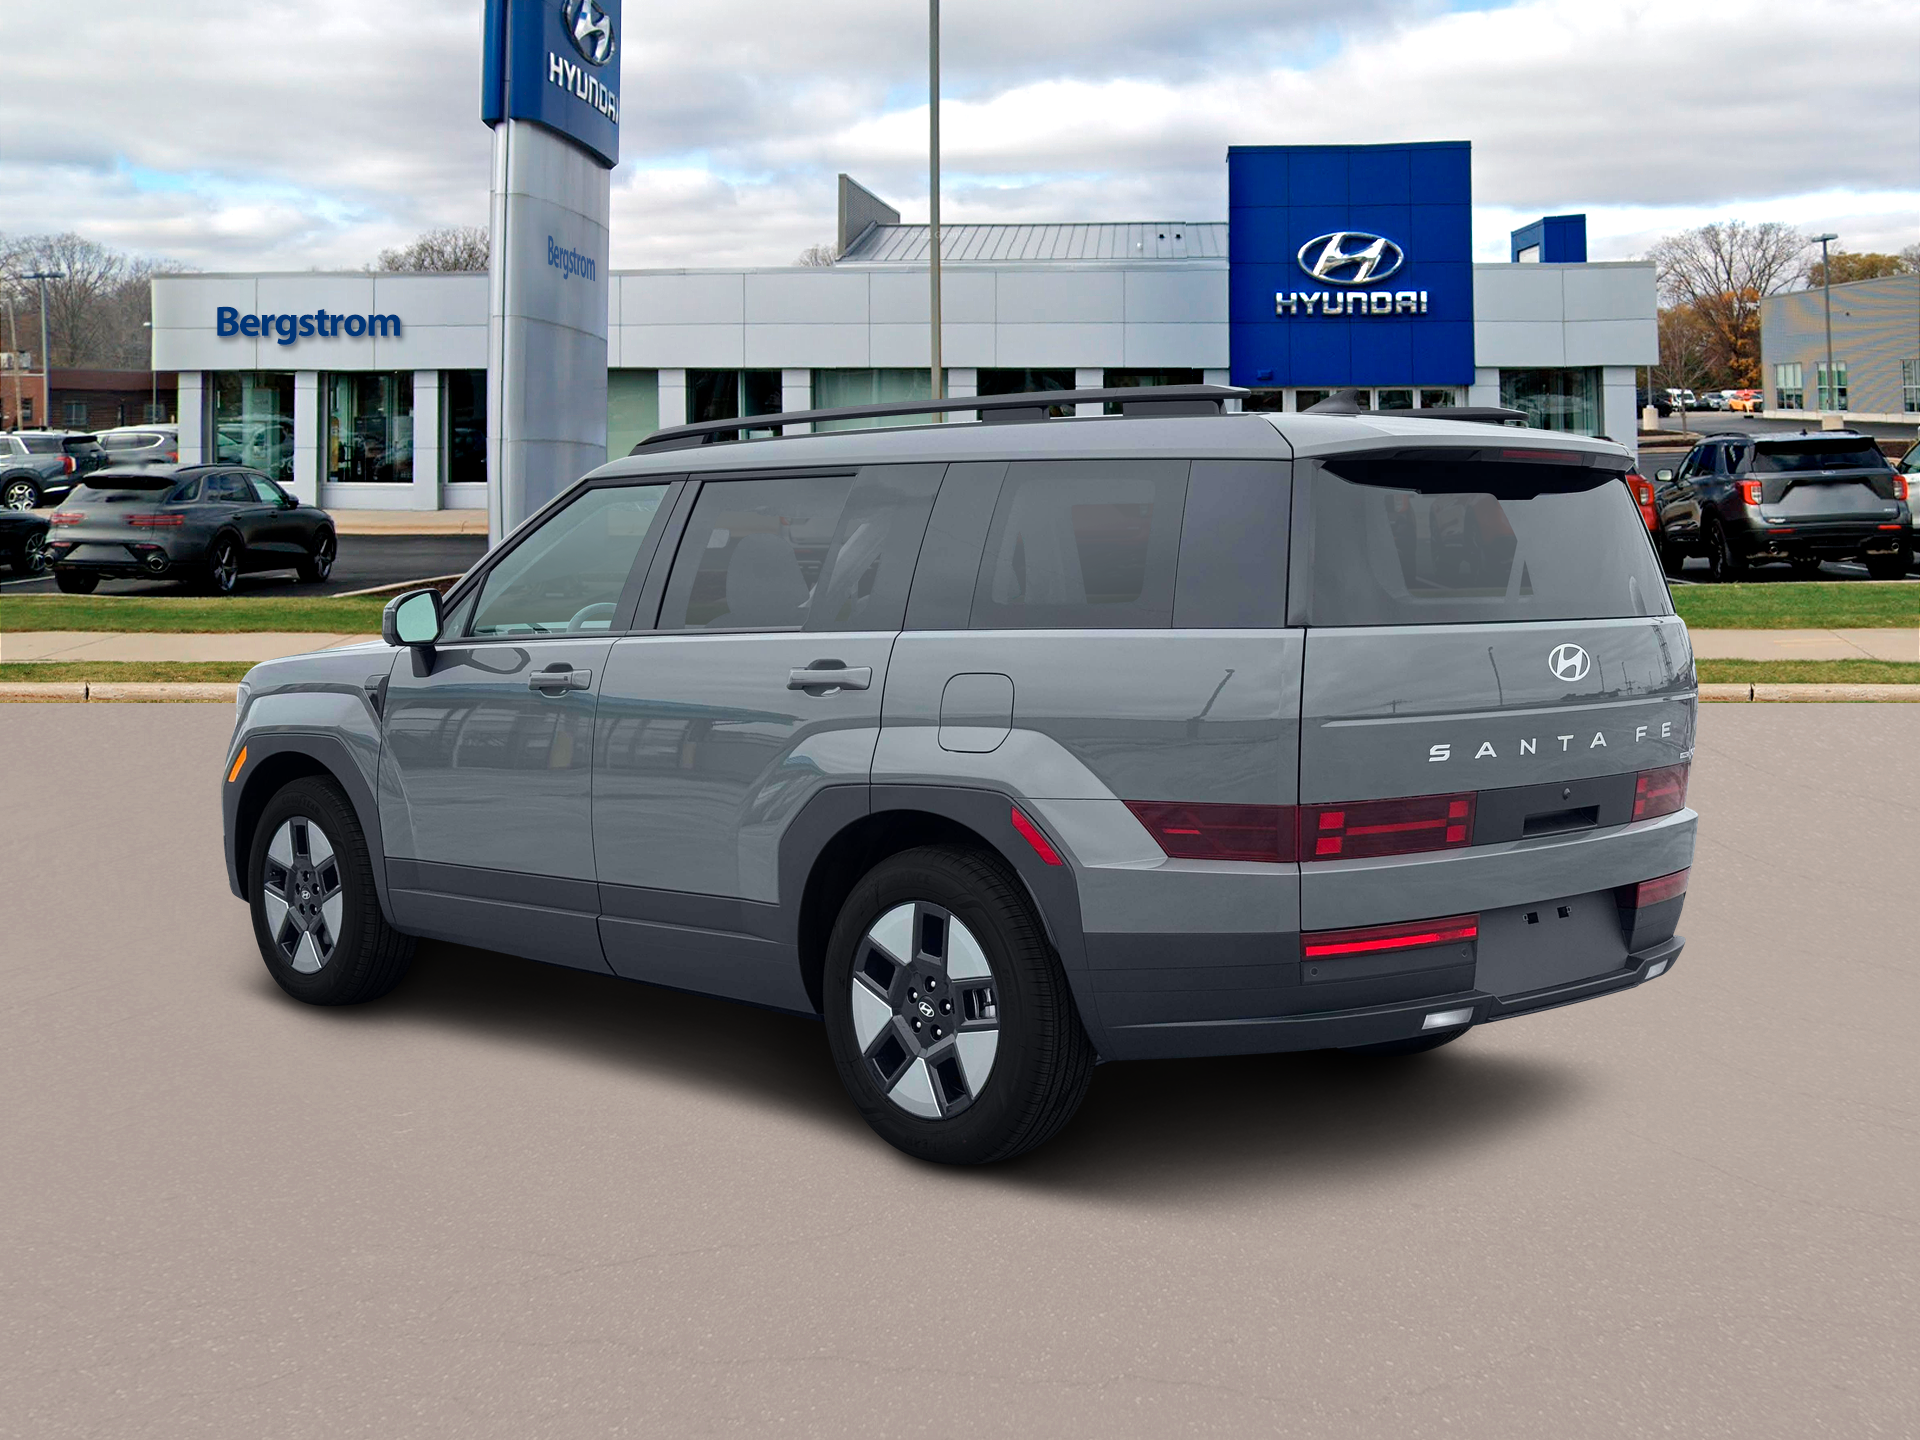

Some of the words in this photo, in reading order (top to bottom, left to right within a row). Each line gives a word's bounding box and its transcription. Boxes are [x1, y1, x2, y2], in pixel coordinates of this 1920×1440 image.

[549, 52, 618, 124] HYUNDAI
[547, 235, 596, 281] Bergstrom
[1275, 290, 1428, 316] HYUNDAI
[216, 306, 401, 345] Bergstrom
[1428, 731, 1607, 762] SANTA
[1635, 721, 1672, 742] FE
